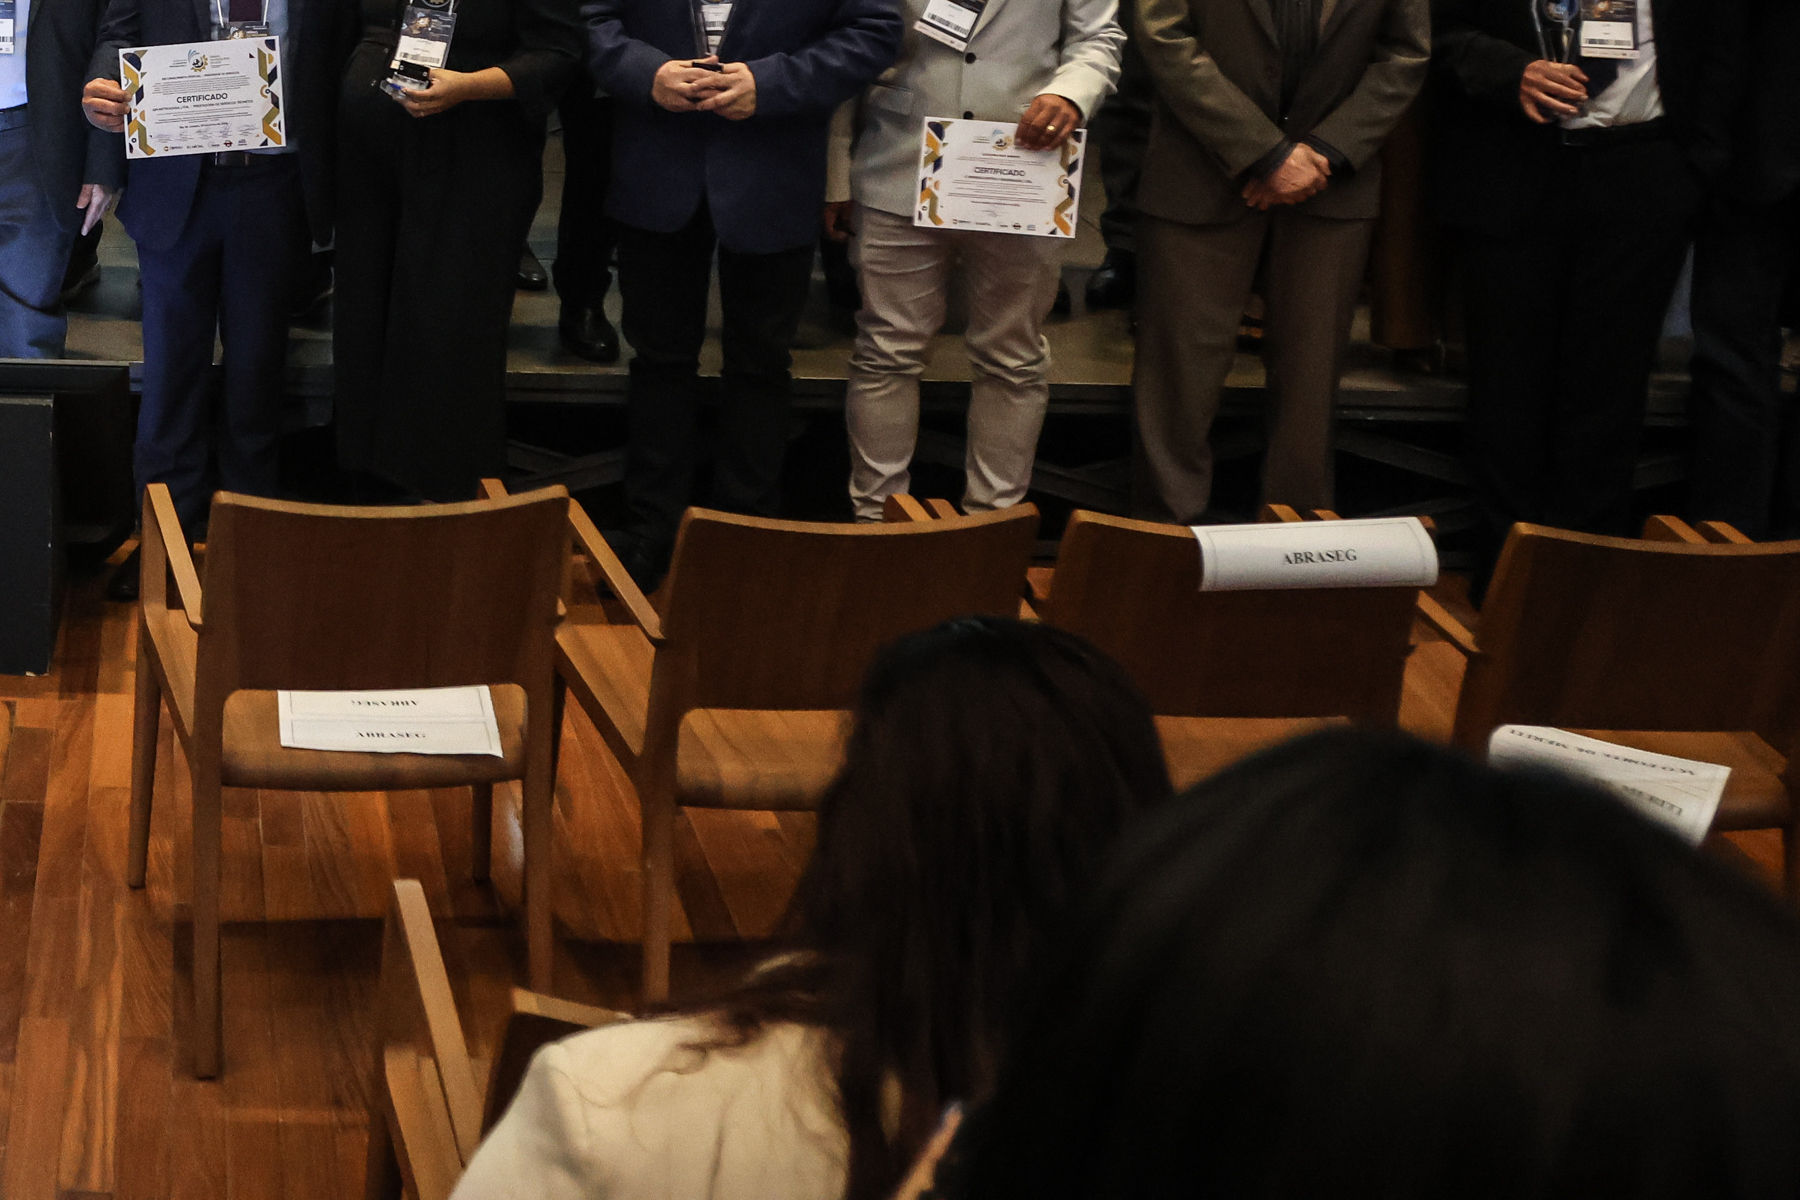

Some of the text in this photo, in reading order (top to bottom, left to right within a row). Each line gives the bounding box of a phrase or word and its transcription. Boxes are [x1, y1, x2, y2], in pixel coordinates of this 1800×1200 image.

[176, 92, 228, 104] CERTIFICADO
[974, 166, 1026, 177] CERTIFICADO
[1282, 548, 1358, 566] ABRASEG
